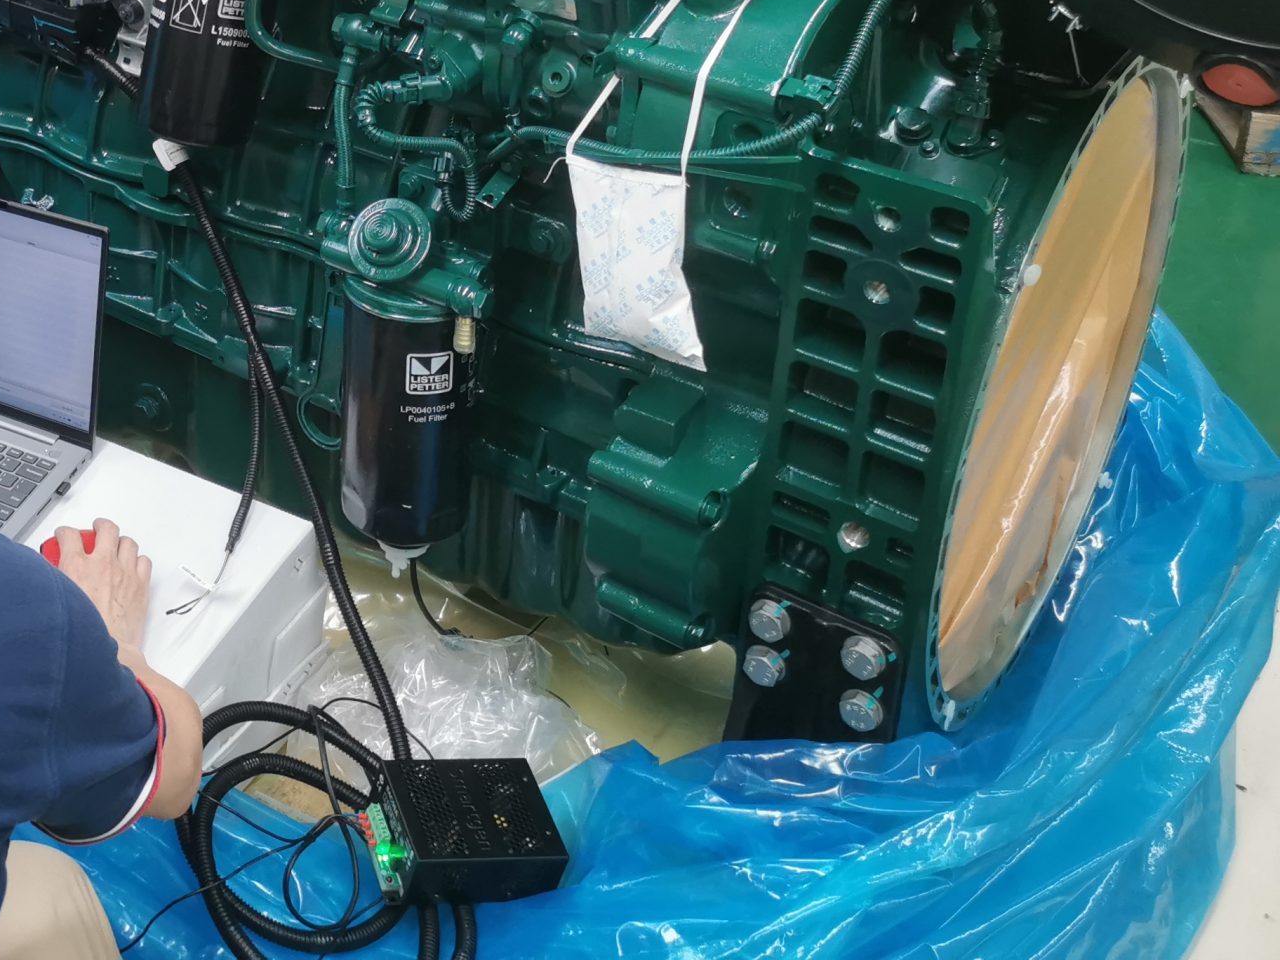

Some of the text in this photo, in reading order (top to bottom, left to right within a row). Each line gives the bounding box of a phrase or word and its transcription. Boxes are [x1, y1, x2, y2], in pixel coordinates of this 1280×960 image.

[222, 7, 245, 16] PETT
[211, 25, 250, 38] L150900
[217, 38, 250, 48] Fuel Filter
[411, 373, 449, 383] LISTER
[410, 382, 448, 391] PETTER
[408, 414, 448, 423] Fuel Filter
